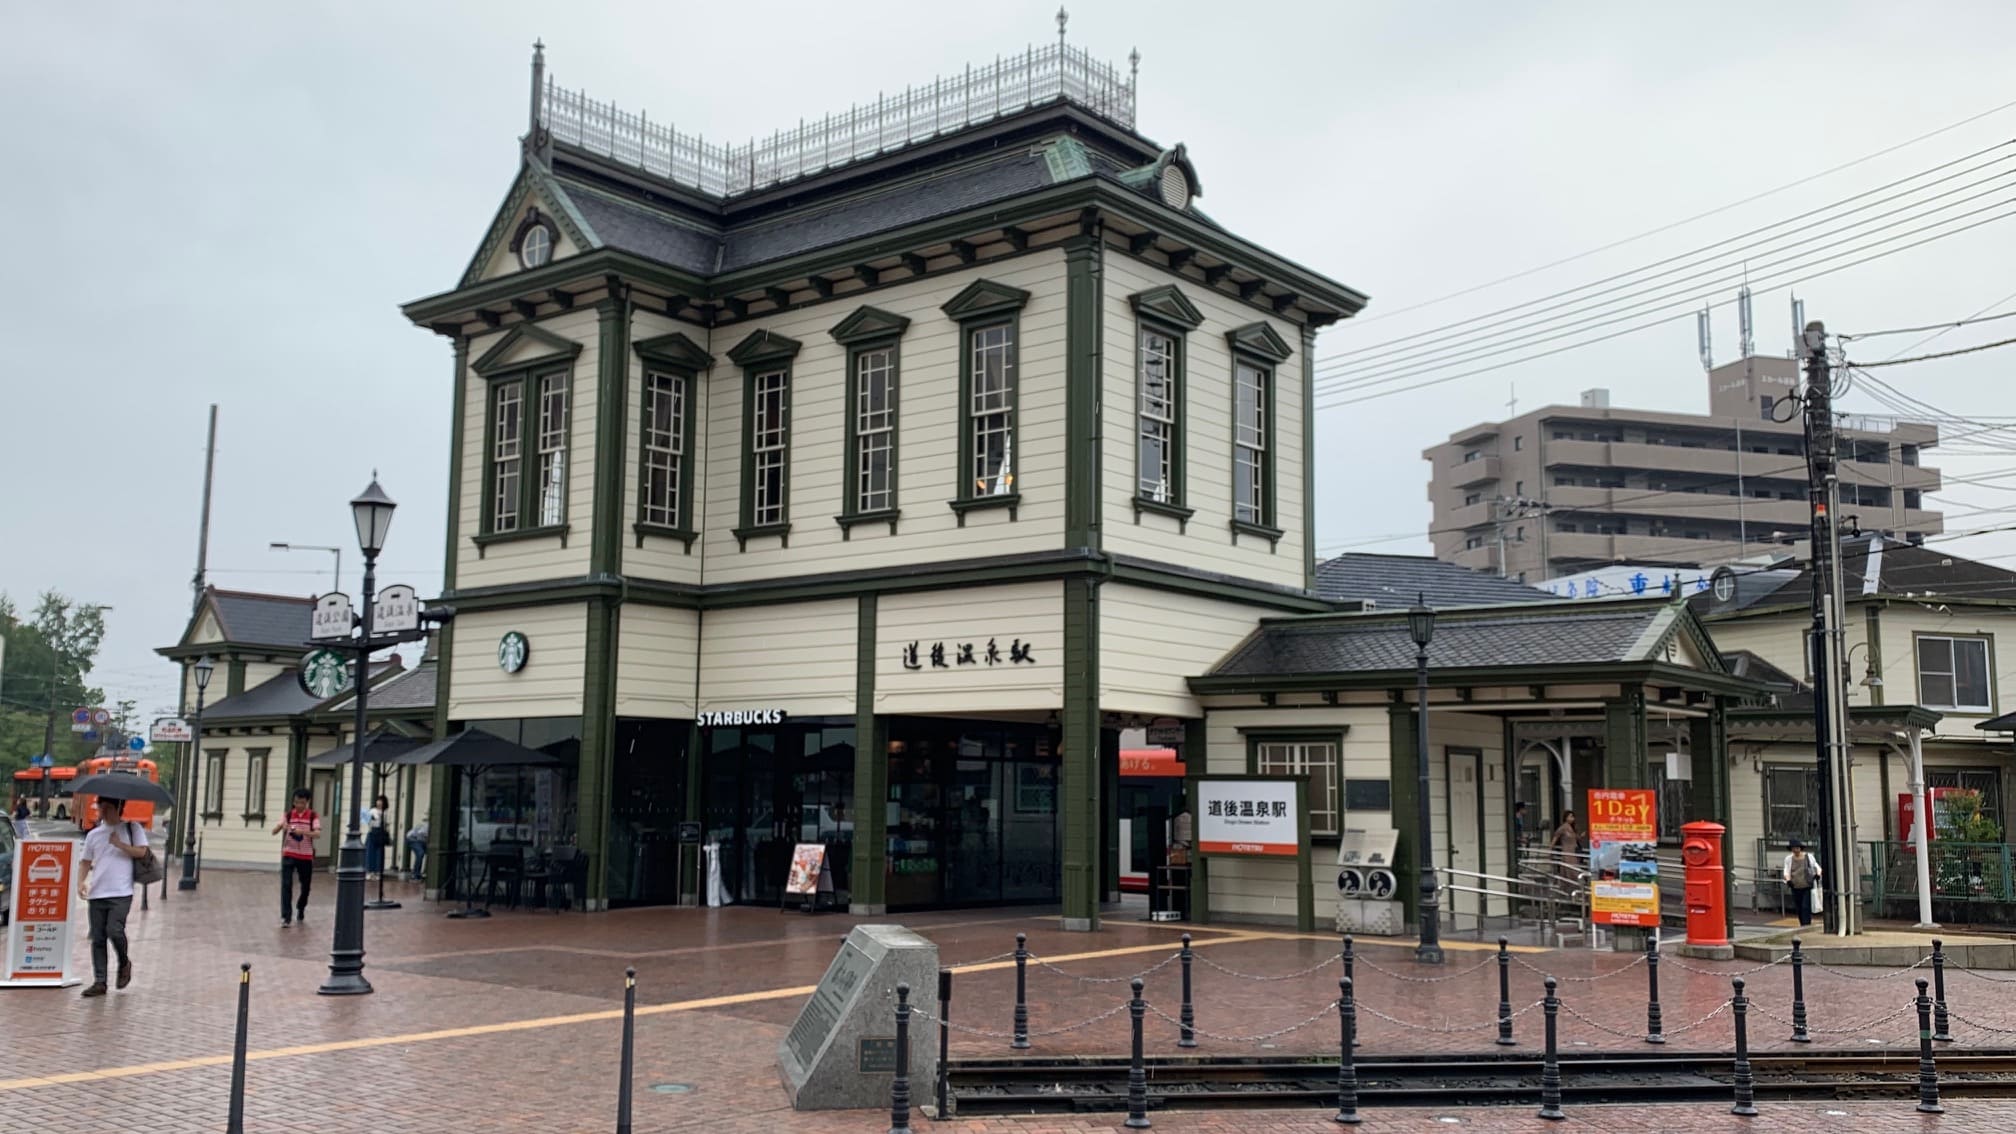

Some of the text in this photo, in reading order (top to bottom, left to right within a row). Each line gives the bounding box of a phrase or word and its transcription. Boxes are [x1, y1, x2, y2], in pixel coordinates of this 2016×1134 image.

[903, 637, 1036, 670] 道後温泉駅
[697, 709, 782, 727] STARBUCKS
[1208, 800, 1287, 818] 道後温泉駅
